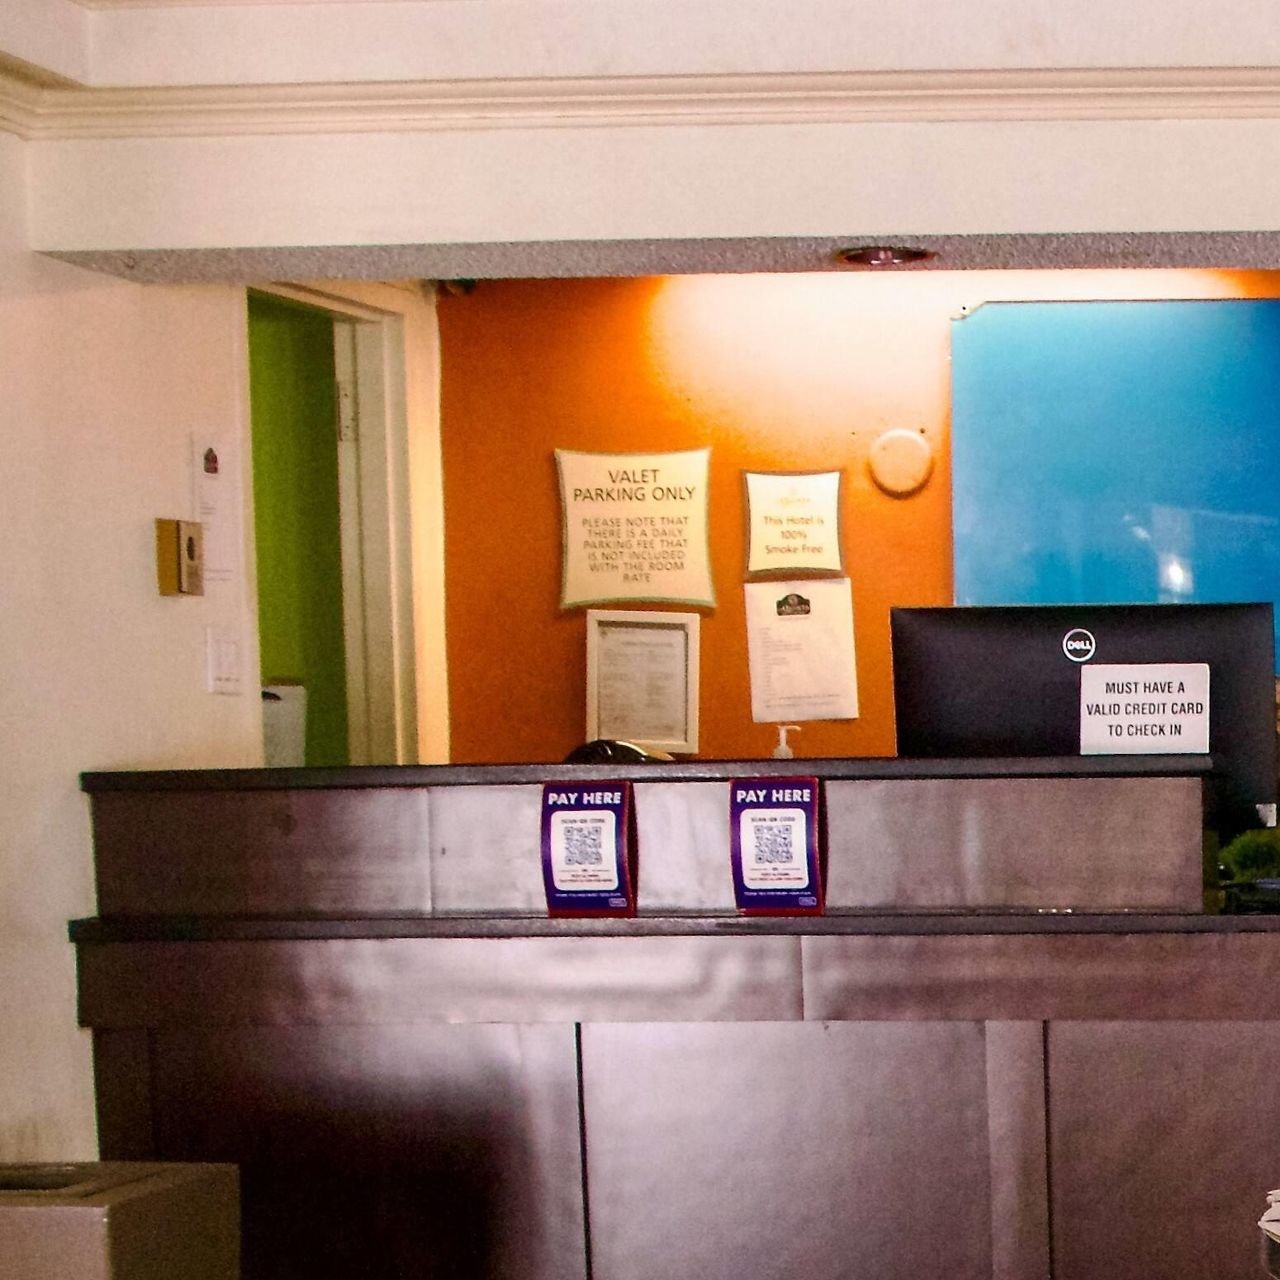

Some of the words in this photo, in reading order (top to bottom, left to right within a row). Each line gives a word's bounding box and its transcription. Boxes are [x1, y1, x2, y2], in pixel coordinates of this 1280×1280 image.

[608, 469, 660, 484] VALET
[574, 487, 646, 502] PARKING
[652, 486, 696, 501] ONLY
[582, 518, 621, 527] PLEASE
[626, 517, 655, 527] NOTE
[660, 516, 689, 526] THAT
[764, 516, 783, 526] This
[786, 516, 813, 525] Hotel
[817, 516, 824, 525] is
[588, 529, 621, 539] THERE
[626, 529, 636, 538] IS
[640, 529, 648, 537] A
[652, 528, 684, 537] DAILY
[781, 530, 807, 540] 100%
[583, 540, 632, 549] PARKING
[637, 540, 656, 549] FEE
[660, 539, 688, 548] THAT
[765, 545, 798, 554] Smoke
[801, 544, 824, 554] Free
[588, 551, 599, 561] IS
[602, 551, 624, 561] NOT
[629, 550, 685, 560] INCLUDED
[590, 563, 619, 572] WITH
[623, 562, 644, 571] THE
[649, 561, 685, 571] ROOM
[623, 573, 651, 582] RATE
[1067, 640, 1092, 650] DELL
[1105, 682, 1139, 694] MUST
[1143, 682, 1173, 694] HAVE
[1177, 682, 1185, 693] A
[1086, 704, 1121, 716] VALID
[1125, 703, 1167, 715] CREDIT
[1171, 703, 1203, 715] CARD
[1108, 725, 1123, 737] TO
[1127, 724, 1166, 736] CHECK
[1170, 724, 1182, 736] IN
[548, 792, 578, 805] PAY
[583, 792, 621, 804] HERE
[736, 790, 766, 803] PAY
[772, 789, 811, 803] HERE
